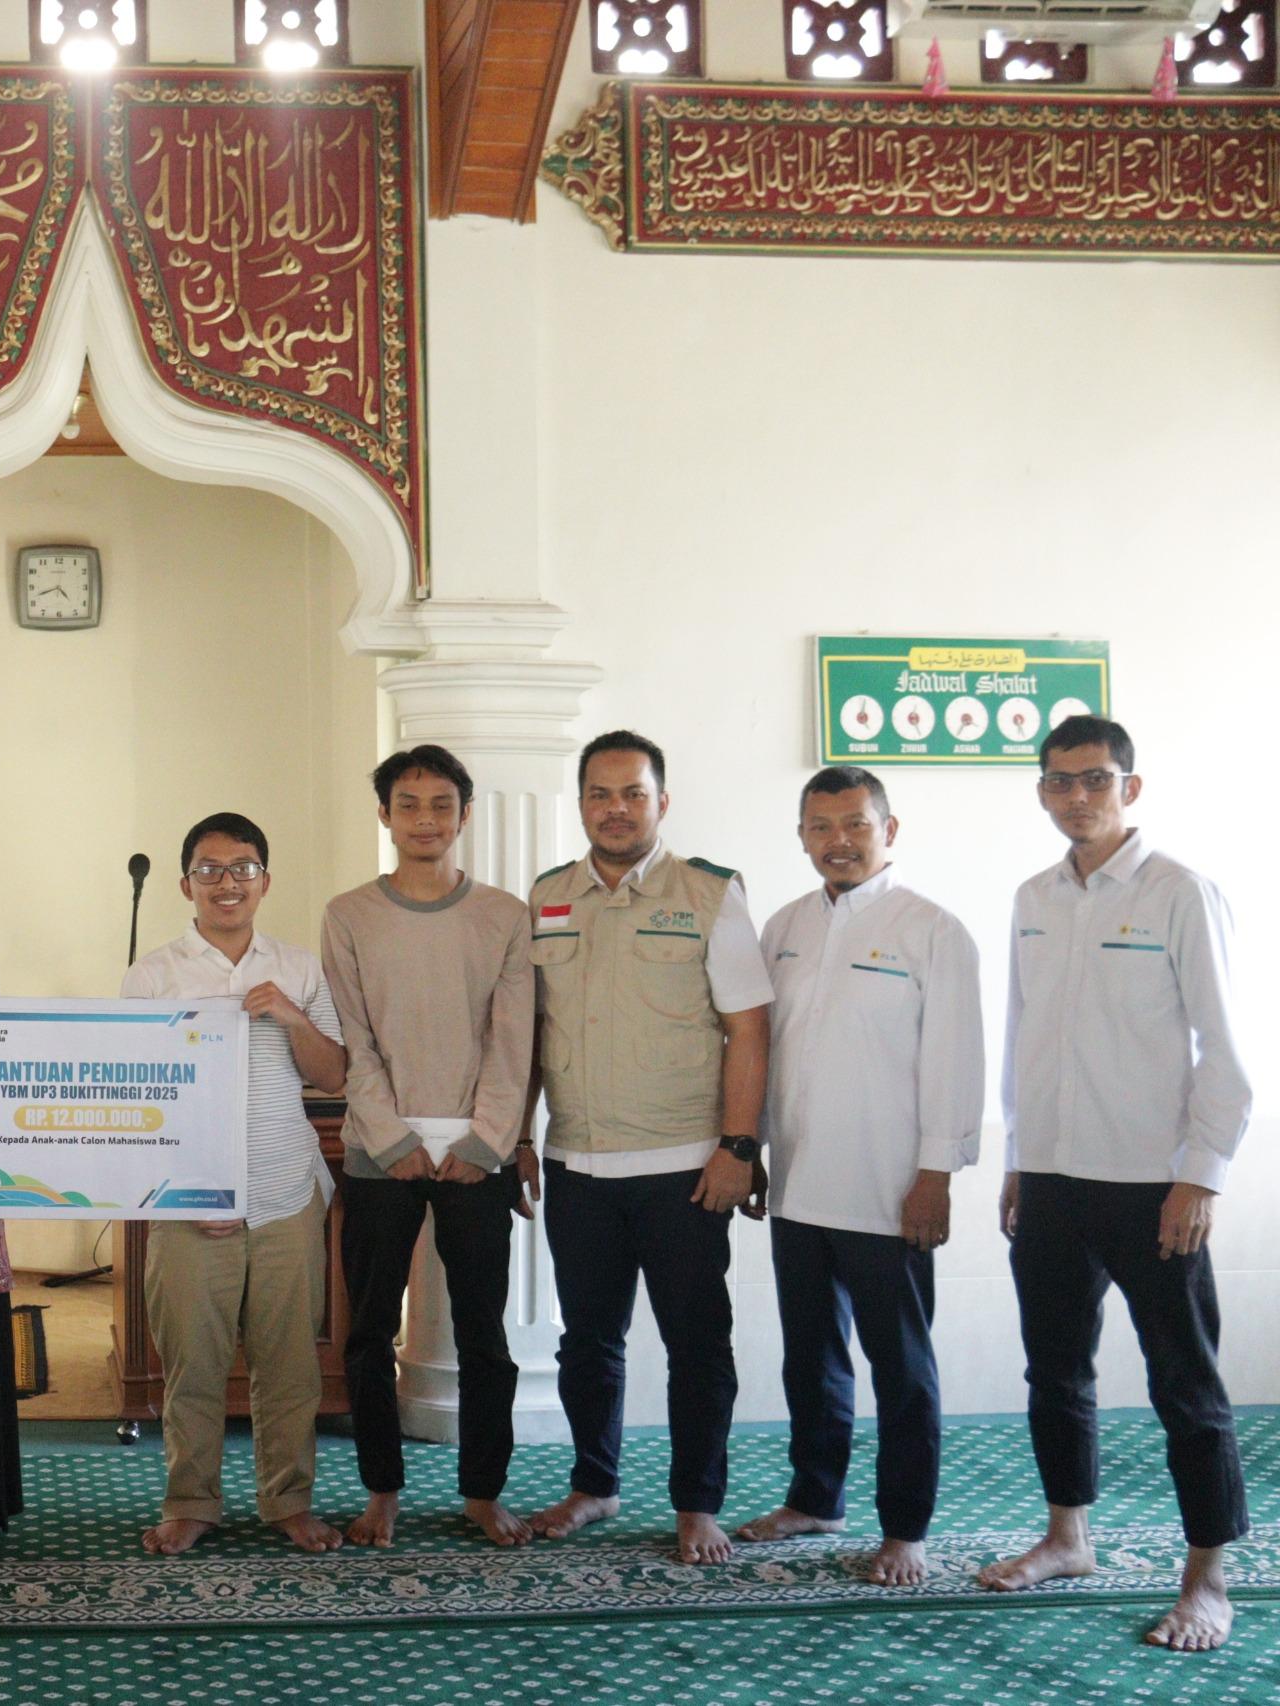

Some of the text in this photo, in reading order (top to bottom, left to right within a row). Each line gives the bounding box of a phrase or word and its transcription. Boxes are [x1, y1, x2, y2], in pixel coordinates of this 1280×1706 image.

[894, 670, 1038, 695] Jadwal Shalat
[201, 1033, 224, 1042] PLN
[79, 1062, 196, 1084] PENDIDIKAN
[0, 1086, 178, 1100] YBM UP3 BUKITTINGGI 2025
[24, 1108, 48, 1126] RP.
[31, 1136, 79, 1145] Anak-anak
[81, 1136, 106, 1145] Calon
[108, 1137, 157, 1146] Mahasiswa
[159, 1138, 180, 1146] Baru
